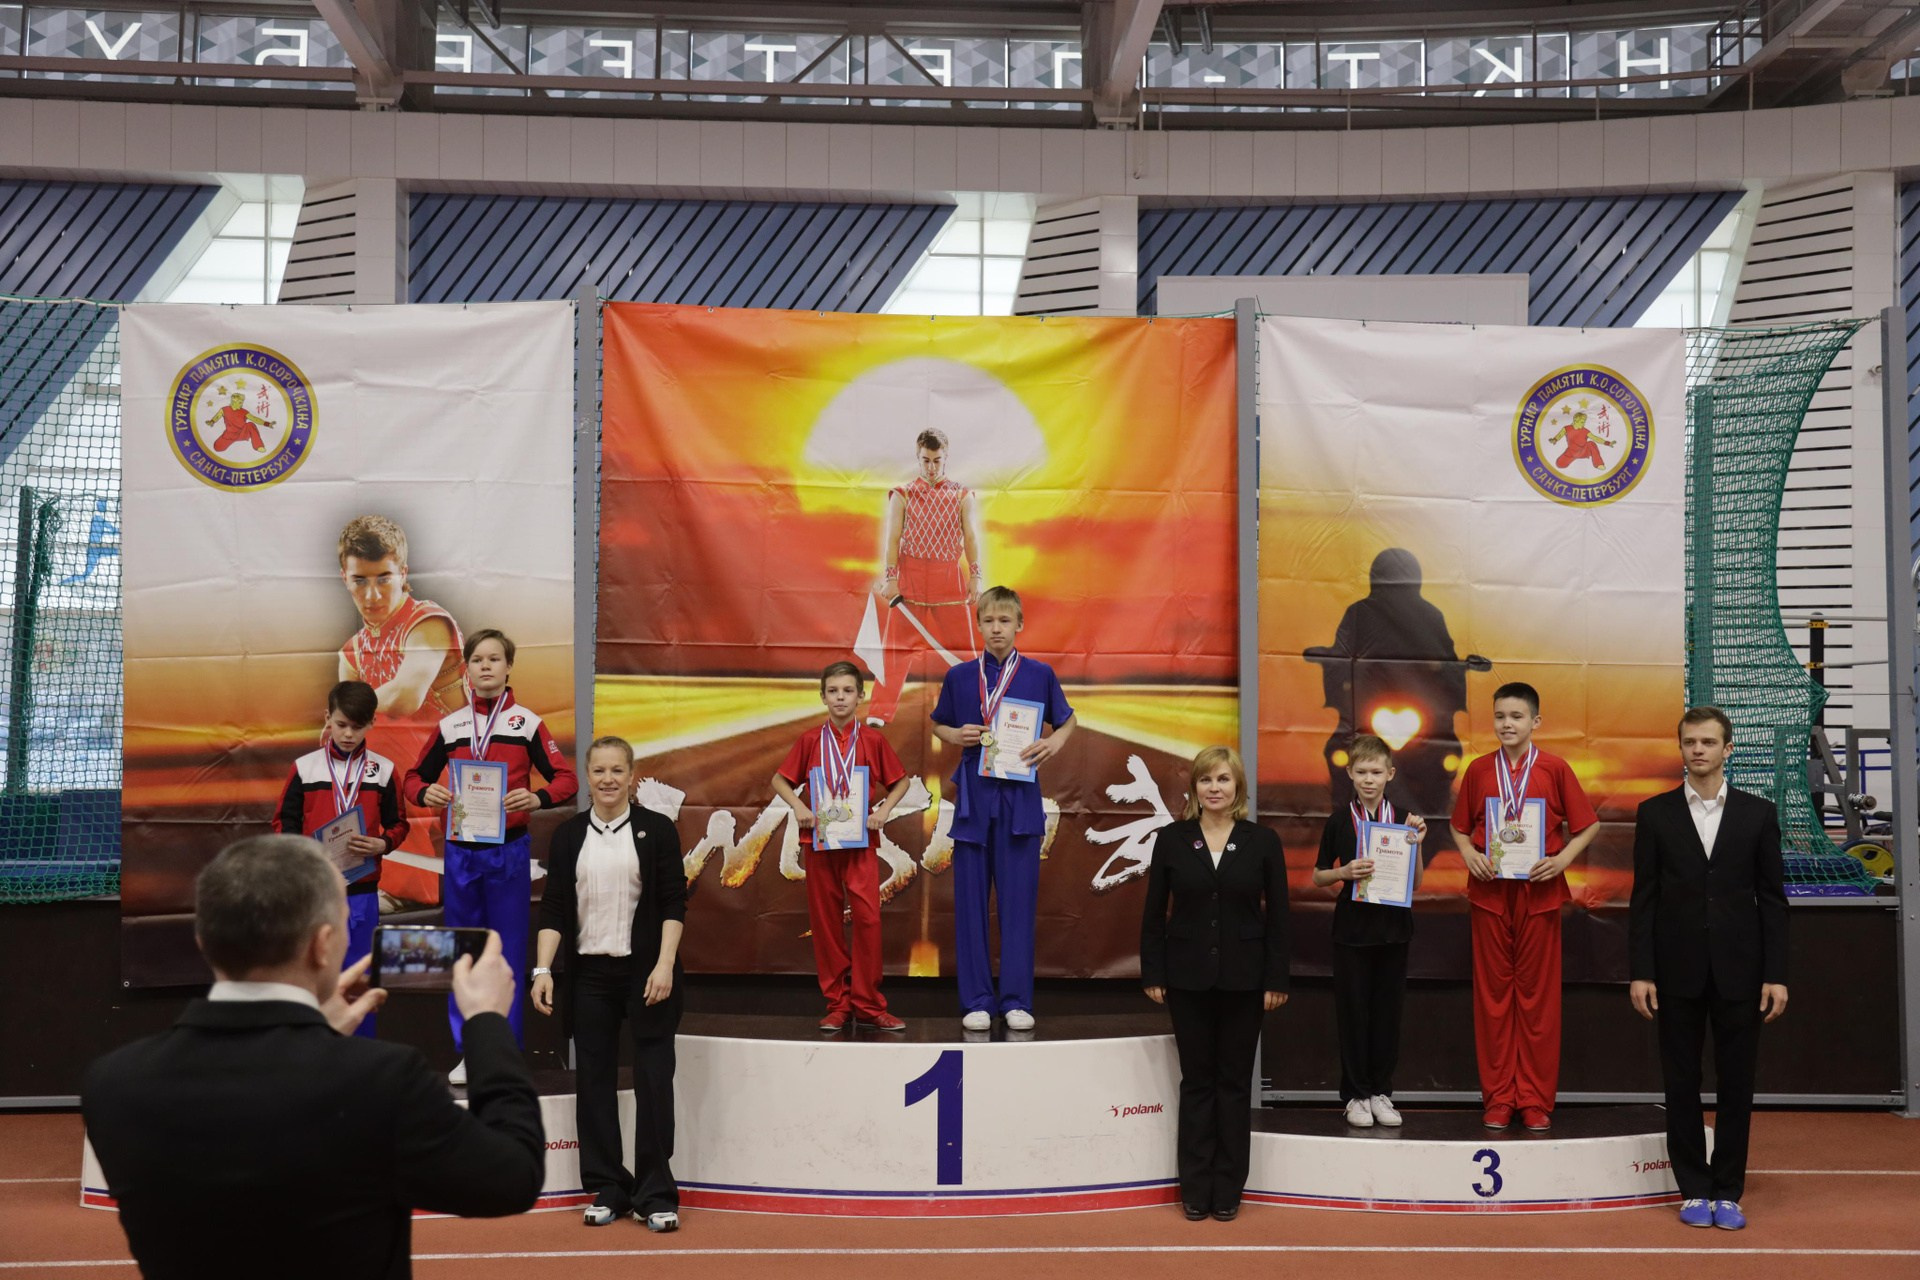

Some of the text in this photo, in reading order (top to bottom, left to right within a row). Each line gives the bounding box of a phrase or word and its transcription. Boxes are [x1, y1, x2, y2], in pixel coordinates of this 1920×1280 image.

[174, 383, 193, 433] ТУРНИР
[189, 352, 240, 383] ПАМЯТИ
[1520, 401, 1540, 448] ТУРНИР
[1537, 372, 1584, 402] ПАМЯТИ
[189, 447, 296, 485] САНКТ-ПЕТЕРБУРГ
[1532, 466, 1634, 500] САНКТ-ПЕТЕРБУРГ
[1004, 721, 1030, 731] Грамота
[467, 784, 495, 792] Грамота
[1375, 847, 1404, 856] Грамота
[904, 1049, 963, 1185] 1
[1122, 1103, 1164, 1118] polanik
[544, 1138, 580, 1151] polan
[1471, 1148, 1503, 1199] 3
[1642, 1158, 1673, 1174] polan
